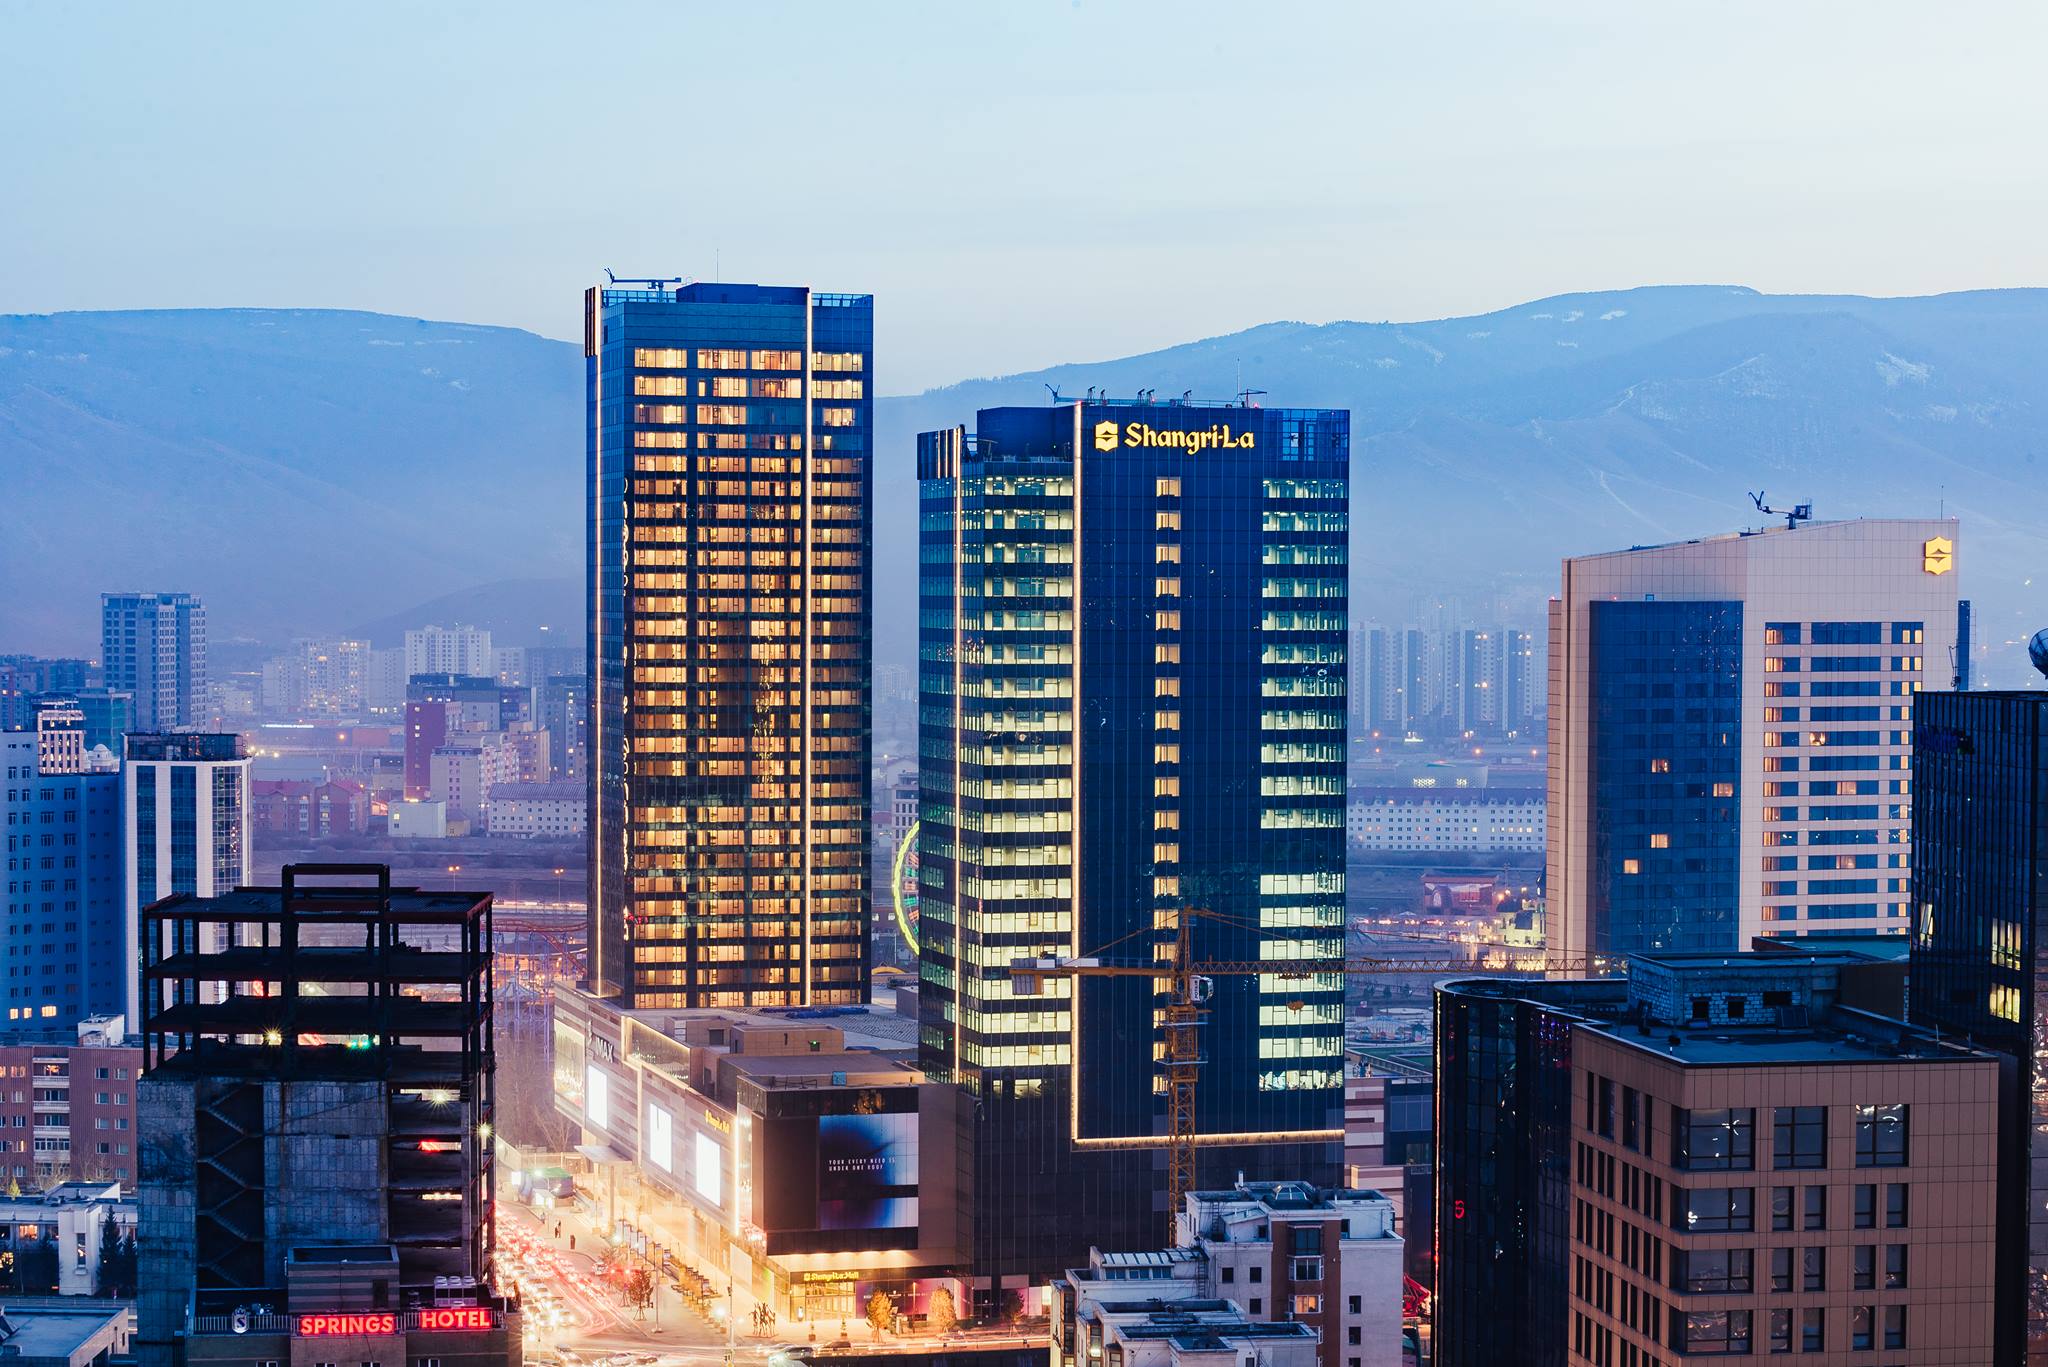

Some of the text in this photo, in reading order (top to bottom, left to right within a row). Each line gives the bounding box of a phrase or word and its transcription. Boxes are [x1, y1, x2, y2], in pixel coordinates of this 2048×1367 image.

[1124, 422, 1255, 456] Shangri-La
[301, 1315, 394, 1335] SPRINGS
[421, 1310, 490, 1329] HOTEL
